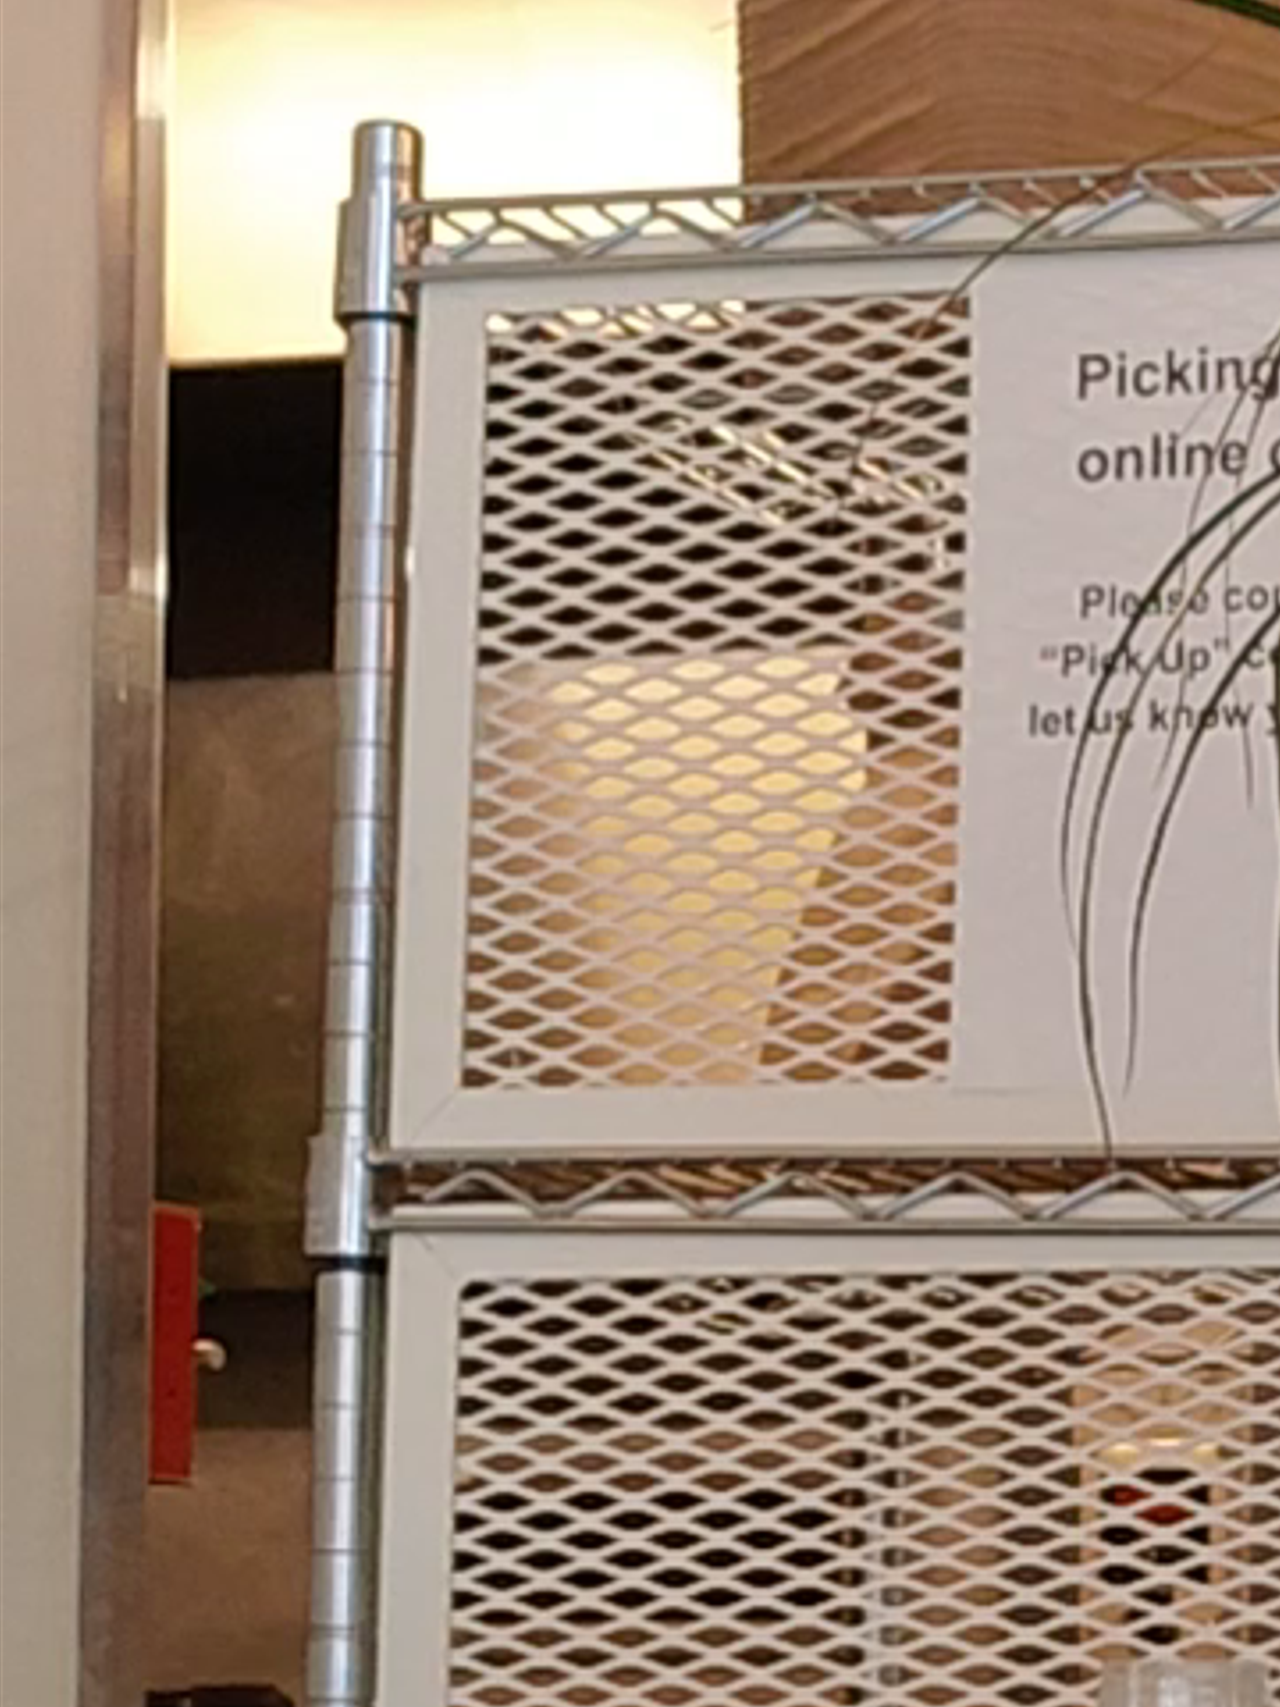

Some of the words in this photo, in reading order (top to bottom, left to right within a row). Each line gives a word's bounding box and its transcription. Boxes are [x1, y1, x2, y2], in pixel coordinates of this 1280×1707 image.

[1077, 347, 1279, 400] Picking
[1077, 432, 1248, 482] online
[1029, 704, 1075, 736] let
